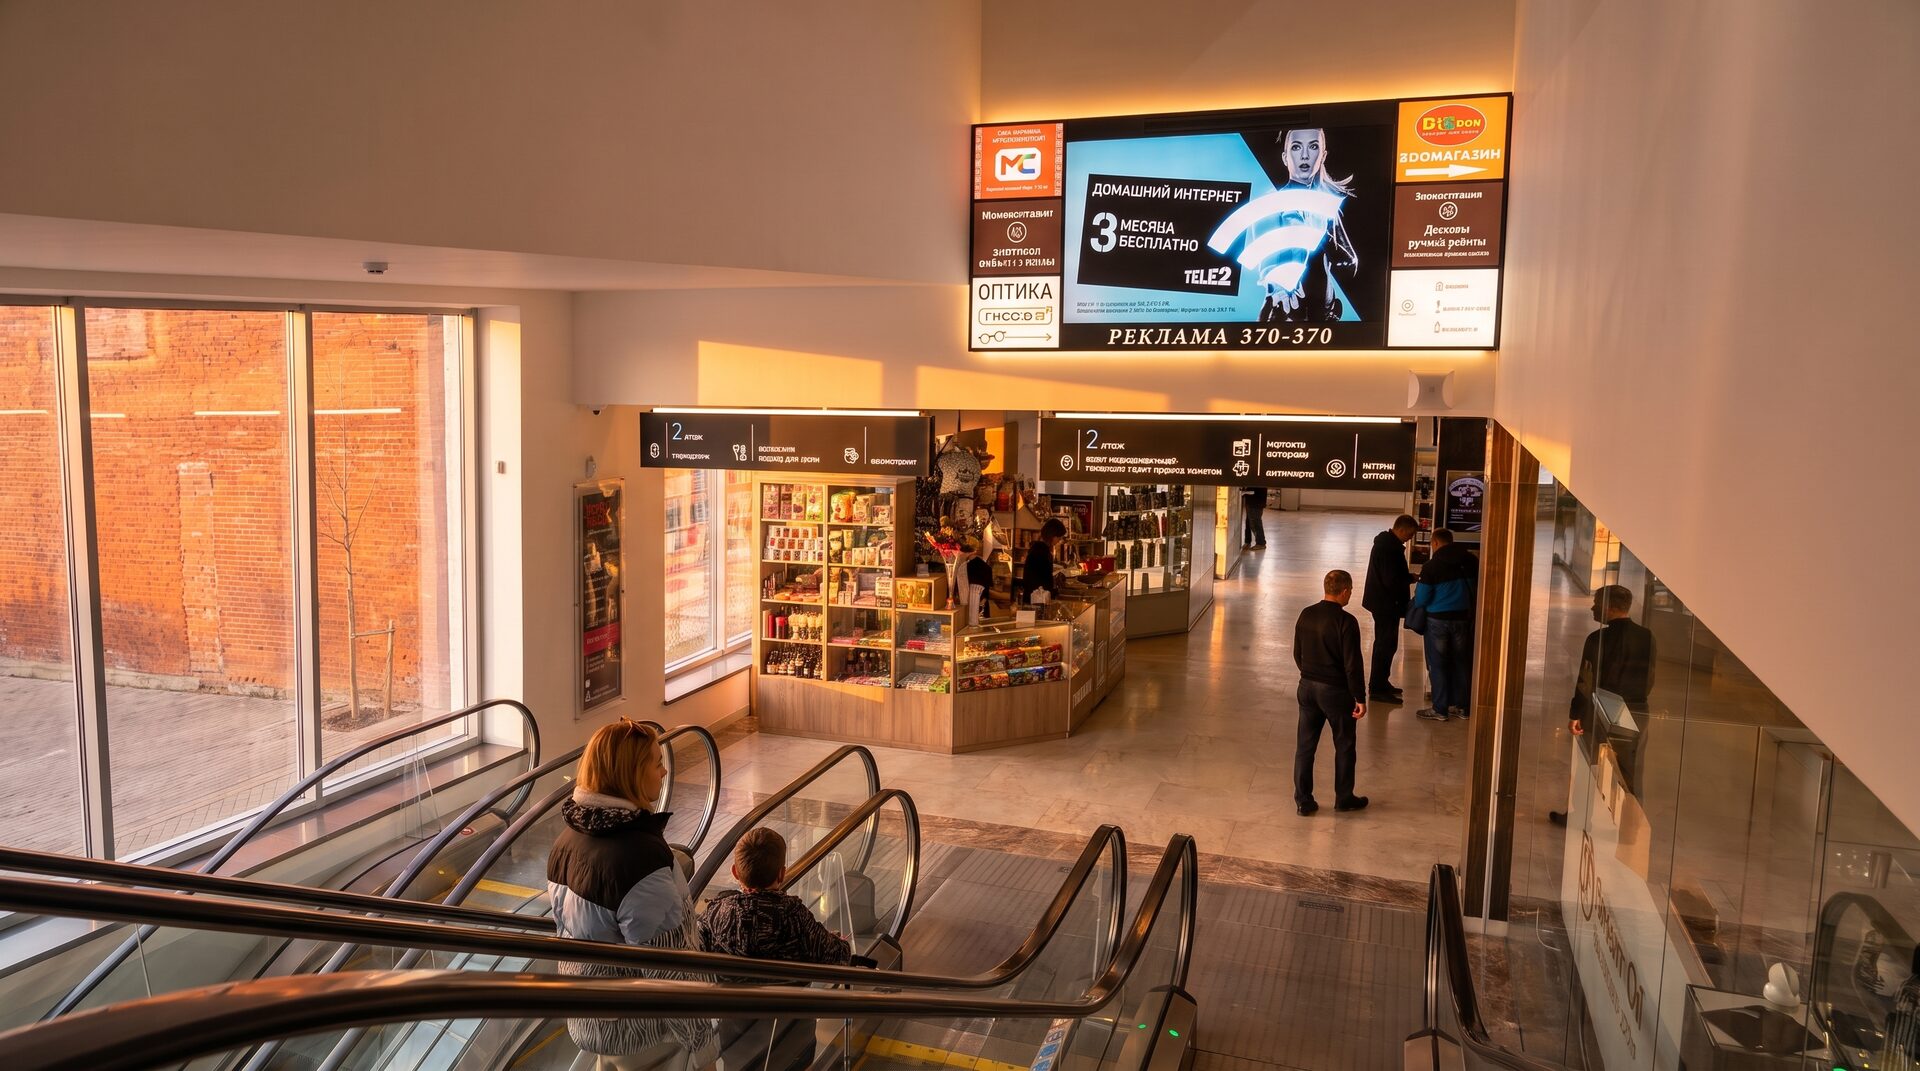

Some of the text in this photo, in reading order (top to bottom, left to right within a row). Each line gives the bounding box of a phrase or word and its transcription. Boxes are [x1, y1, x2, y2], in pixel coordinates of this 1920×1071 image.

[1092, 183, 1242, 203] ДОМАШНИЙ ИНТЕРНЕТ
[1090, 212, 1118, 253] 3
[1119, 235, 1199, 252] БЕСПЛАТНО
[1184, 266, 1232, 286] TELE2
[978, 282, 1053, 301] ОПТИКА
[1107, 327, 1333, 345] РЕКЛАМА 370-370
[672, 422, 682, 440] 2
[1086, 429, 1099, 449] 2
